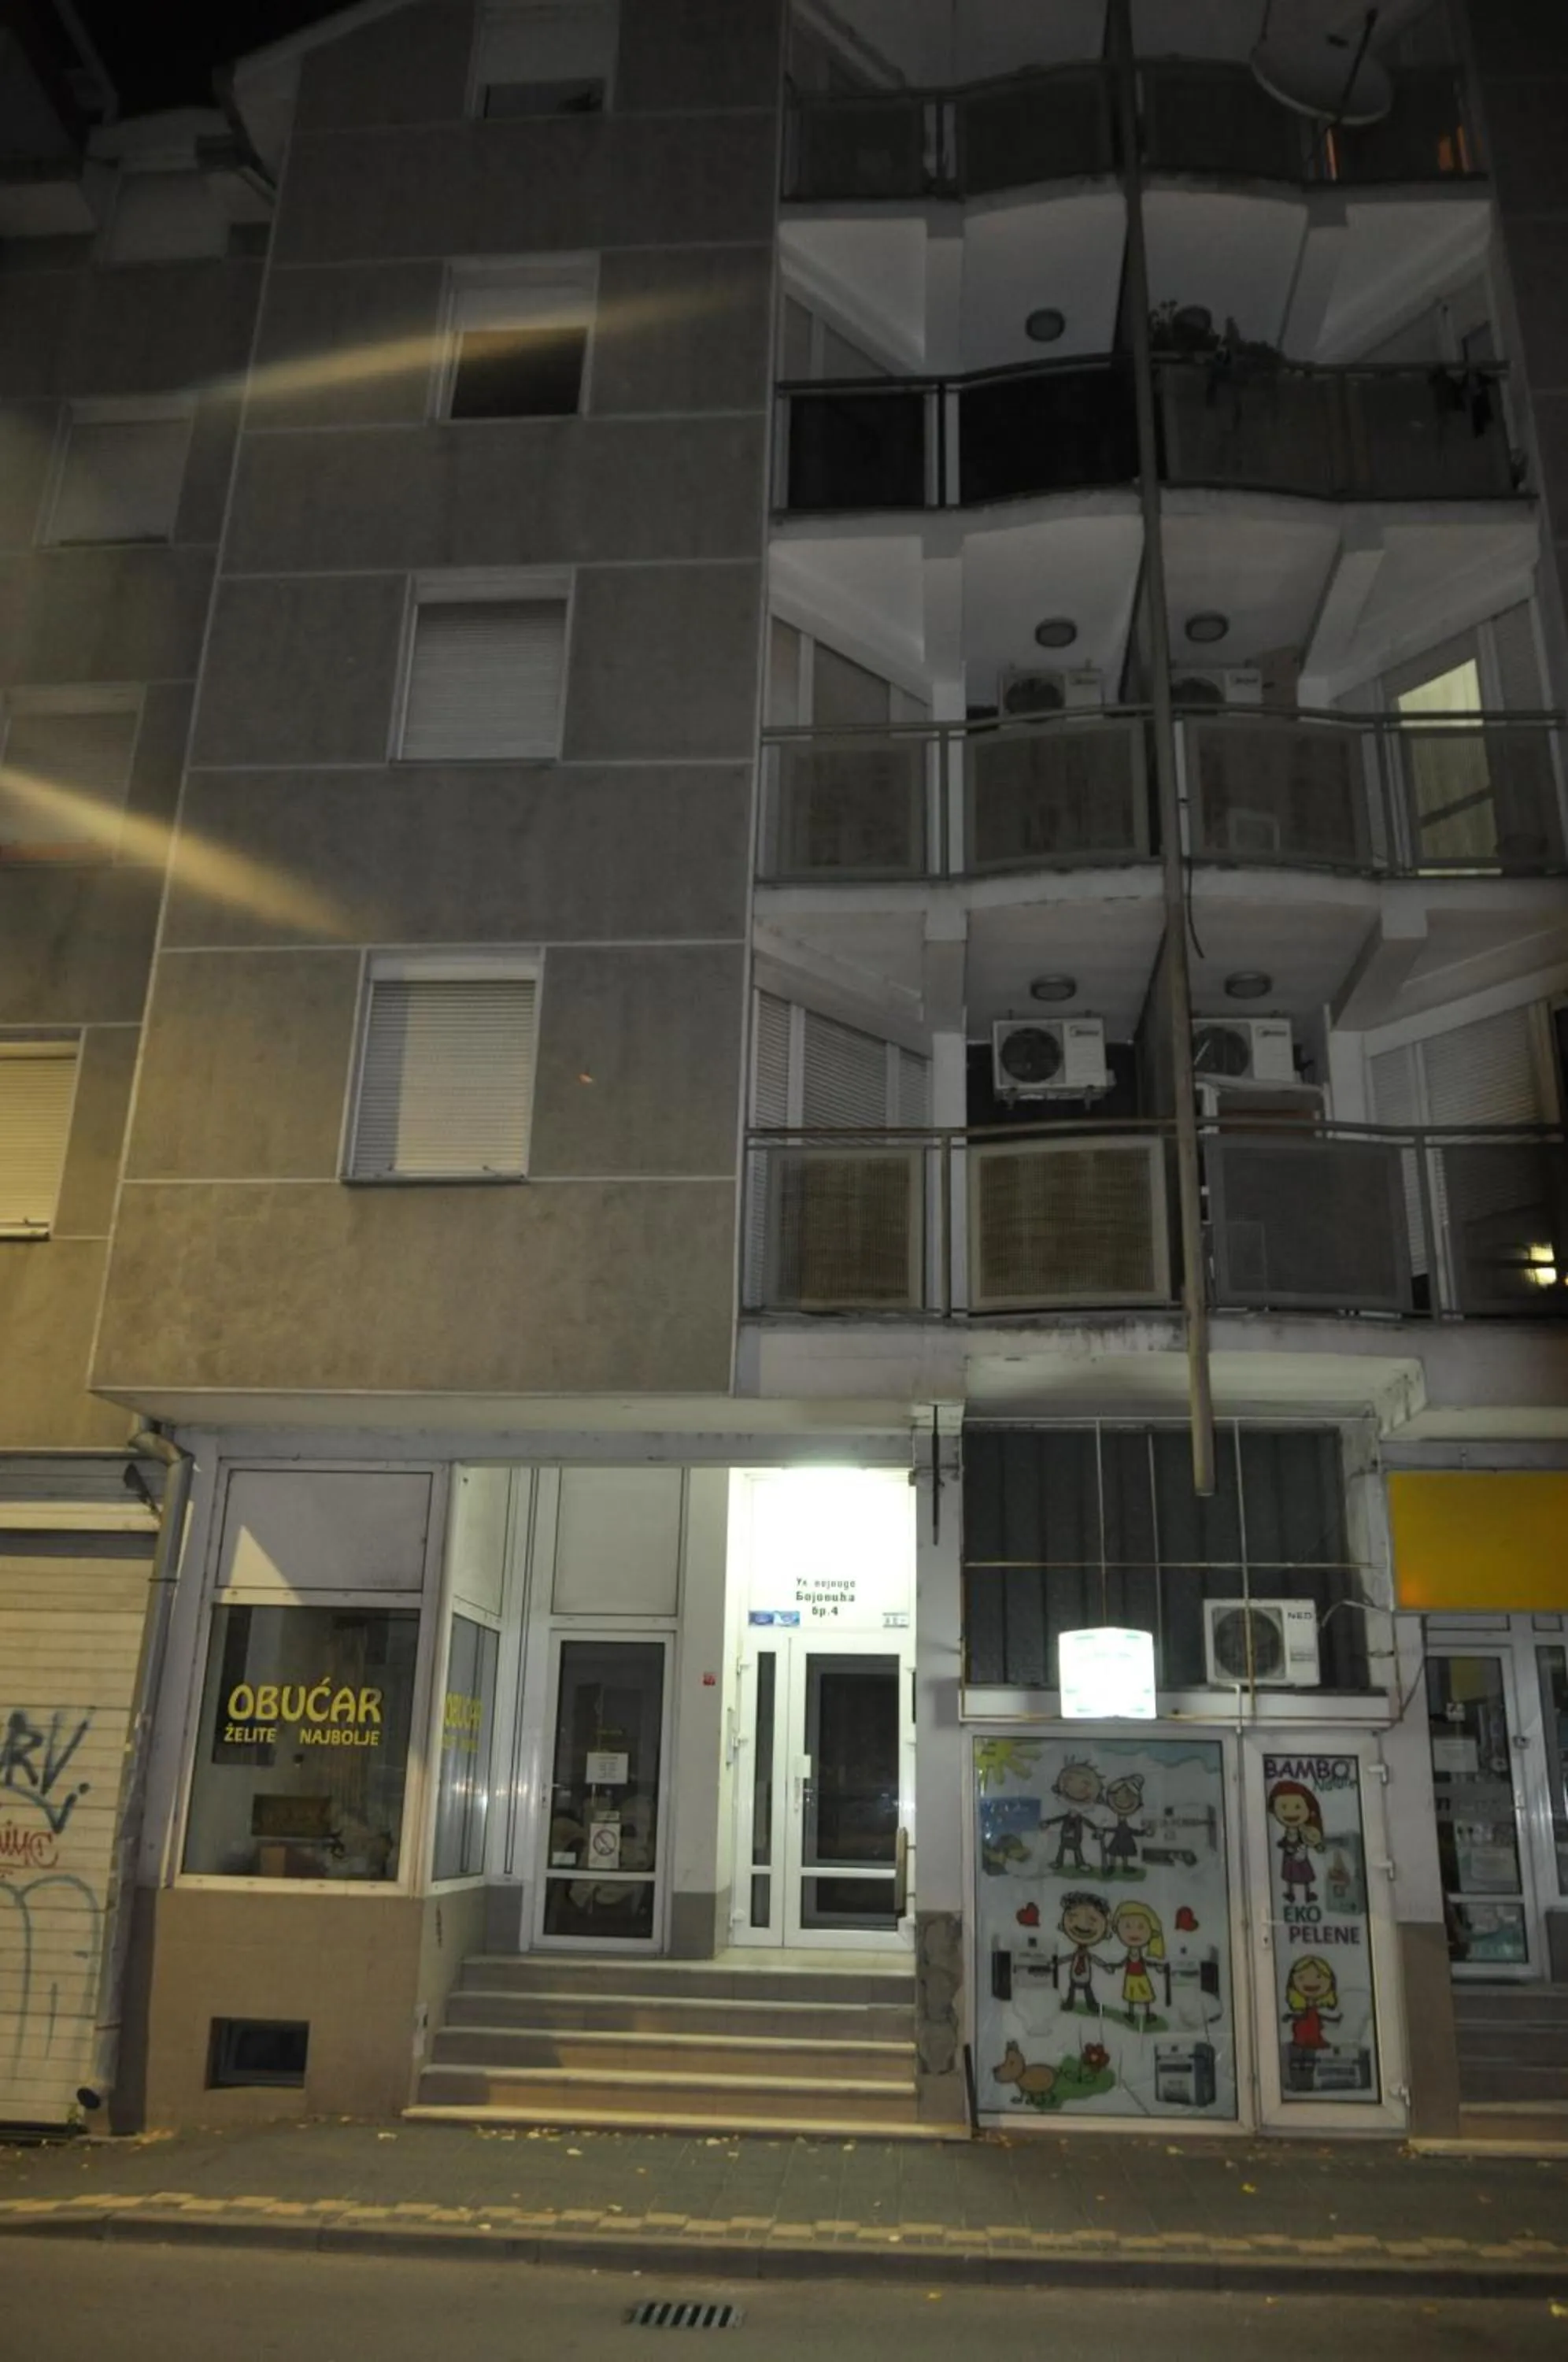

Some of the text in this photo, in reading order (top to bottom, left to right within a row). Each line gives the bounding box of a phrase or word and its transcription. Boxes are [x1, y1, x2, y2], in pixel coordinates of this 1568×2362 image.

[227, 1676, 383, 1723] OBUĆAR
[224, 1723, 380, 1746] ŽELITE NAJBOLJE
[1263, 1758, 1350, 1779] BAMBO
[1283, 1905, 1322, 1923] EKO
[1289, 1926, 1361, 1946] PELENE
